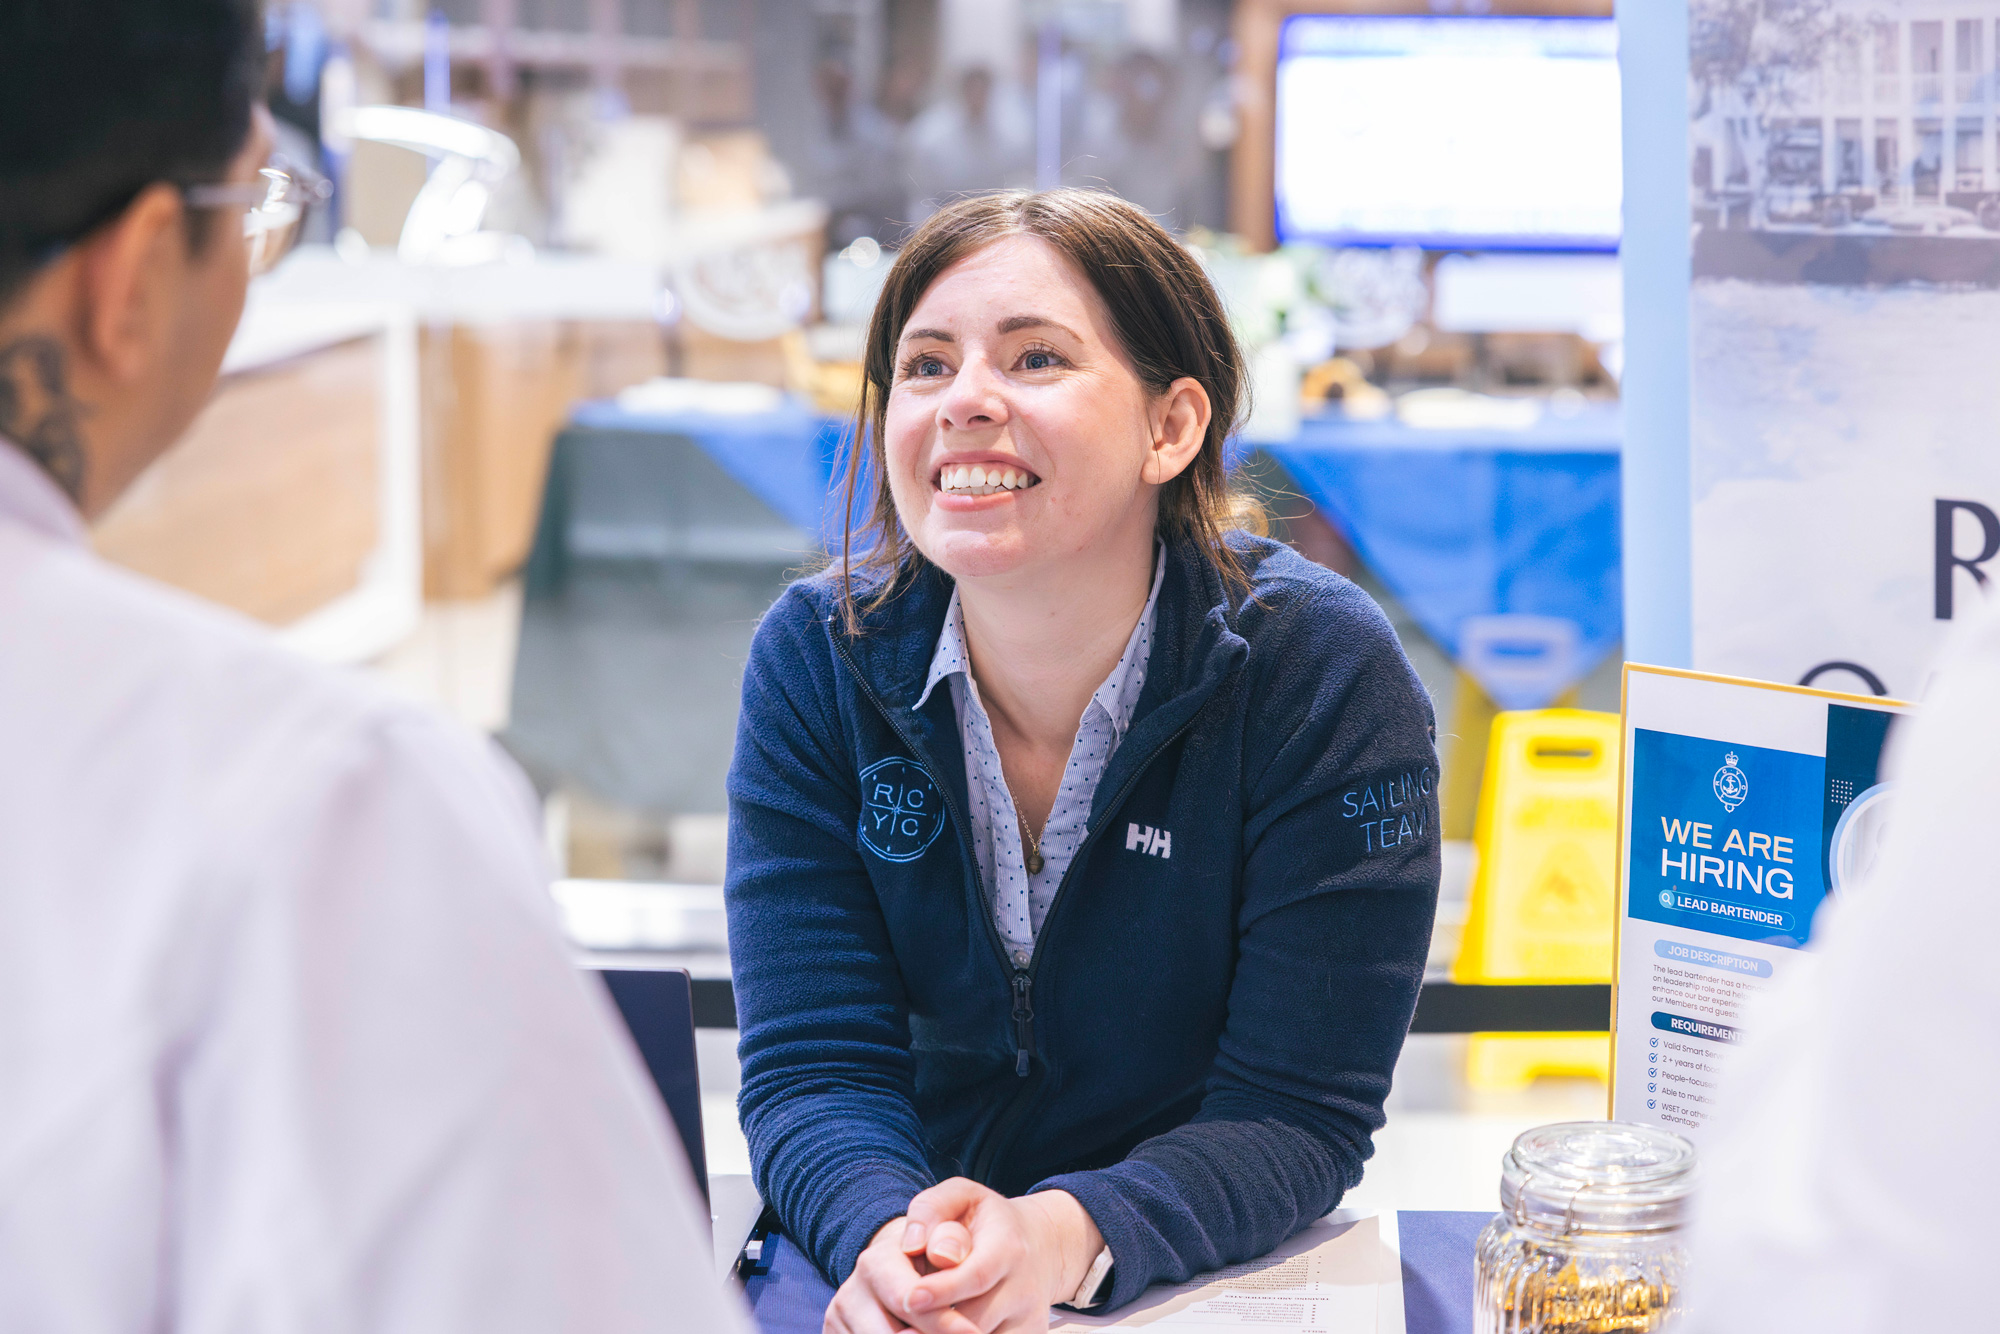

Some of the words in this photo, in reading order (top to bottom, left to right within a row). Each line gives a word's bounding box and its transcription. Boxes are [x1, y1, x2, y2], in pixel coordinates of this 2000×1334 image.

[1342, 766, 1432, 818] SAILING
[1125, 823, 1171, 859] HH
[1661, 816, 1713, 850] WE
[1722, 828, 1794, 864] ARE
[1661, 848, 1794, 900] HIRING
[1677, 896, 1709, 913] LEAD
[1711, 902, 1783, 926] BARTENDER
[1668, 945, 1689, 958] JOB
[1691, 950, 1759, 972] DESCRIPTION
[1653, 964, 1666, 973] The
[1667, 967, 1683, 977] lead
[1684, 970, 1719, 984] bartender
[1721, 978, 1735, 988] has
[1653, 975, 1662, 983] on
[1663, 975, 1701, 991] leadership
[1701, 984, 1716, 994] role
[1716, 987, 1731, 997] and
[1652, 985, 1683, 997] enhance
[1698, 993, 1710, 1002] bar
[1652, 995, 1664, 1003] our
[1665, 997, 1698, 1010] Members
[1699, 1005, 1714, 1013] and
[1663, 1041, 1681, 1051] Valid
[1682, 1045, 1704, 1056] Smart
[1662, 1055, 1668, 1063] 2
[1674, 1059, 1694, 1069] years
[1661, 1088, 1677, 1096] Able
[1678, 1090, 1686, 1098] to
[1661, 1103, 1680, 1113] WSET
[1681, 1107, 1689, 1115] or
[1661, 1113, 1700, 1129] advantage
